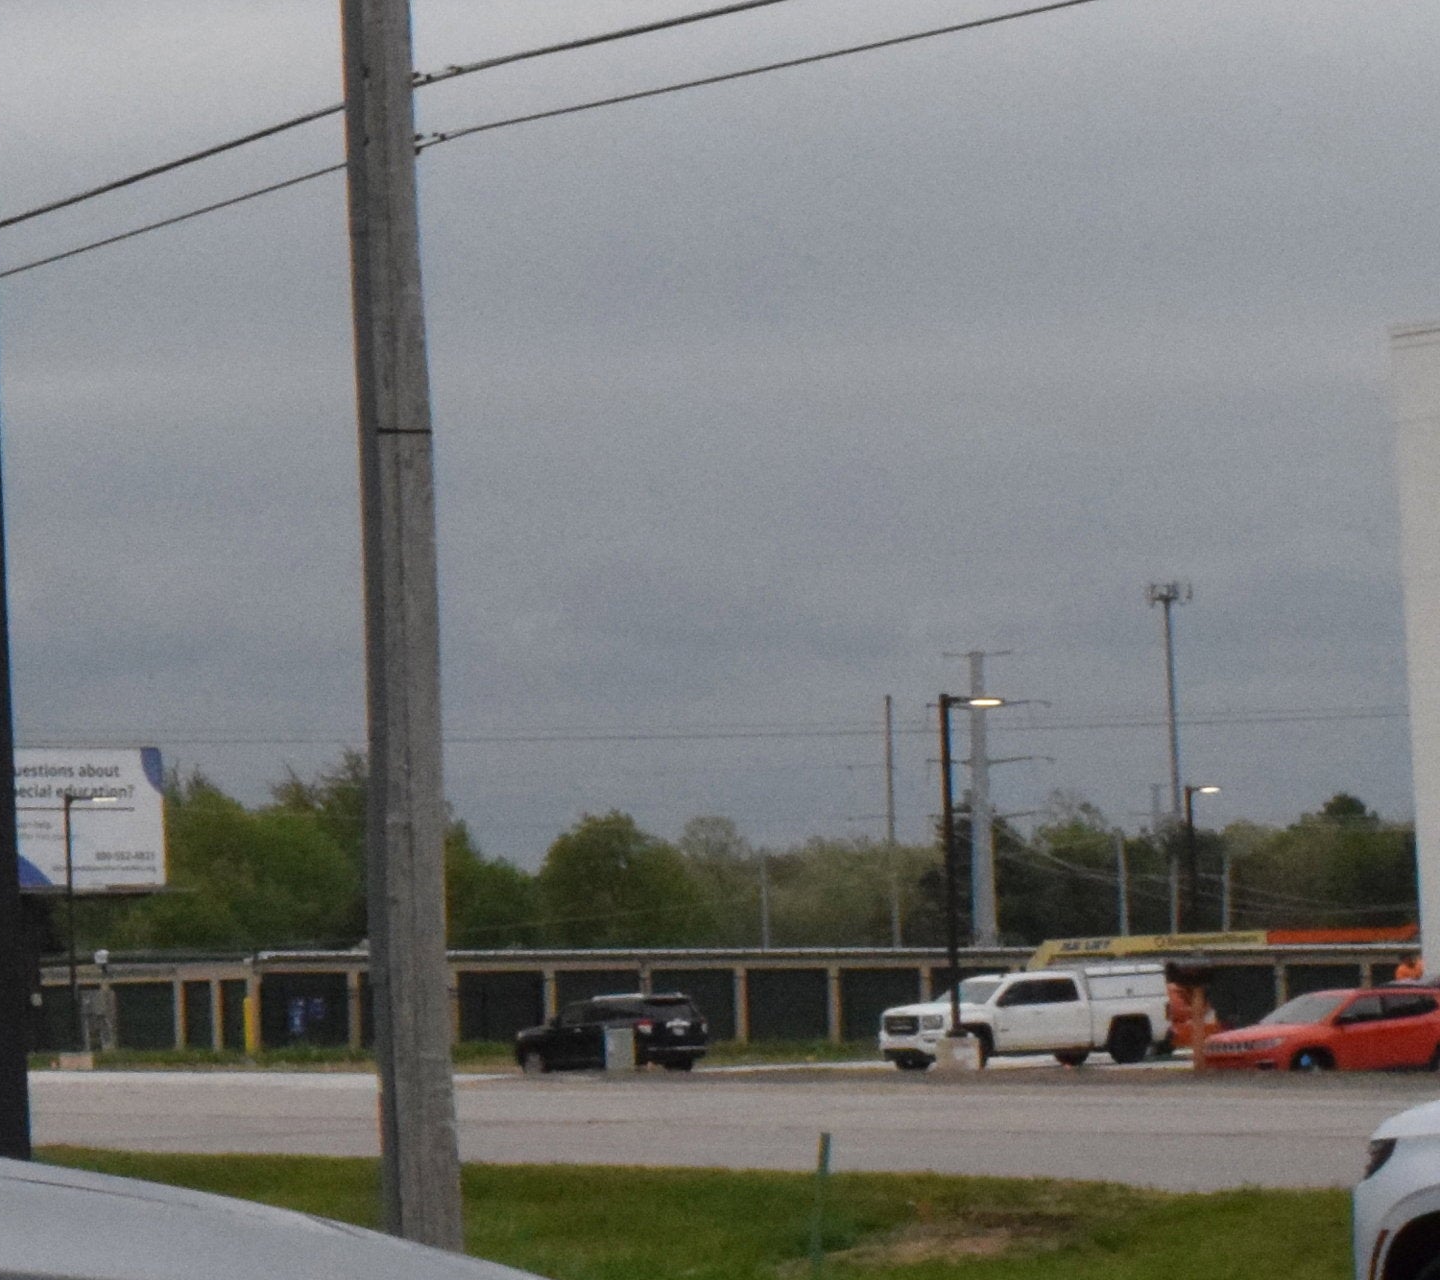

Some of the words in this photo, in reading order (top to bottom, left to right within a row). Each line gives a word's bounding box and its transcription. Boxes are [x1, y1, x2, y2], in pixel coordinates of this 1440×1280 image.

[15, 763, 74, 778] uestions
[78, 763, 121, 778] about
[55, 783, 136, 798] education?
